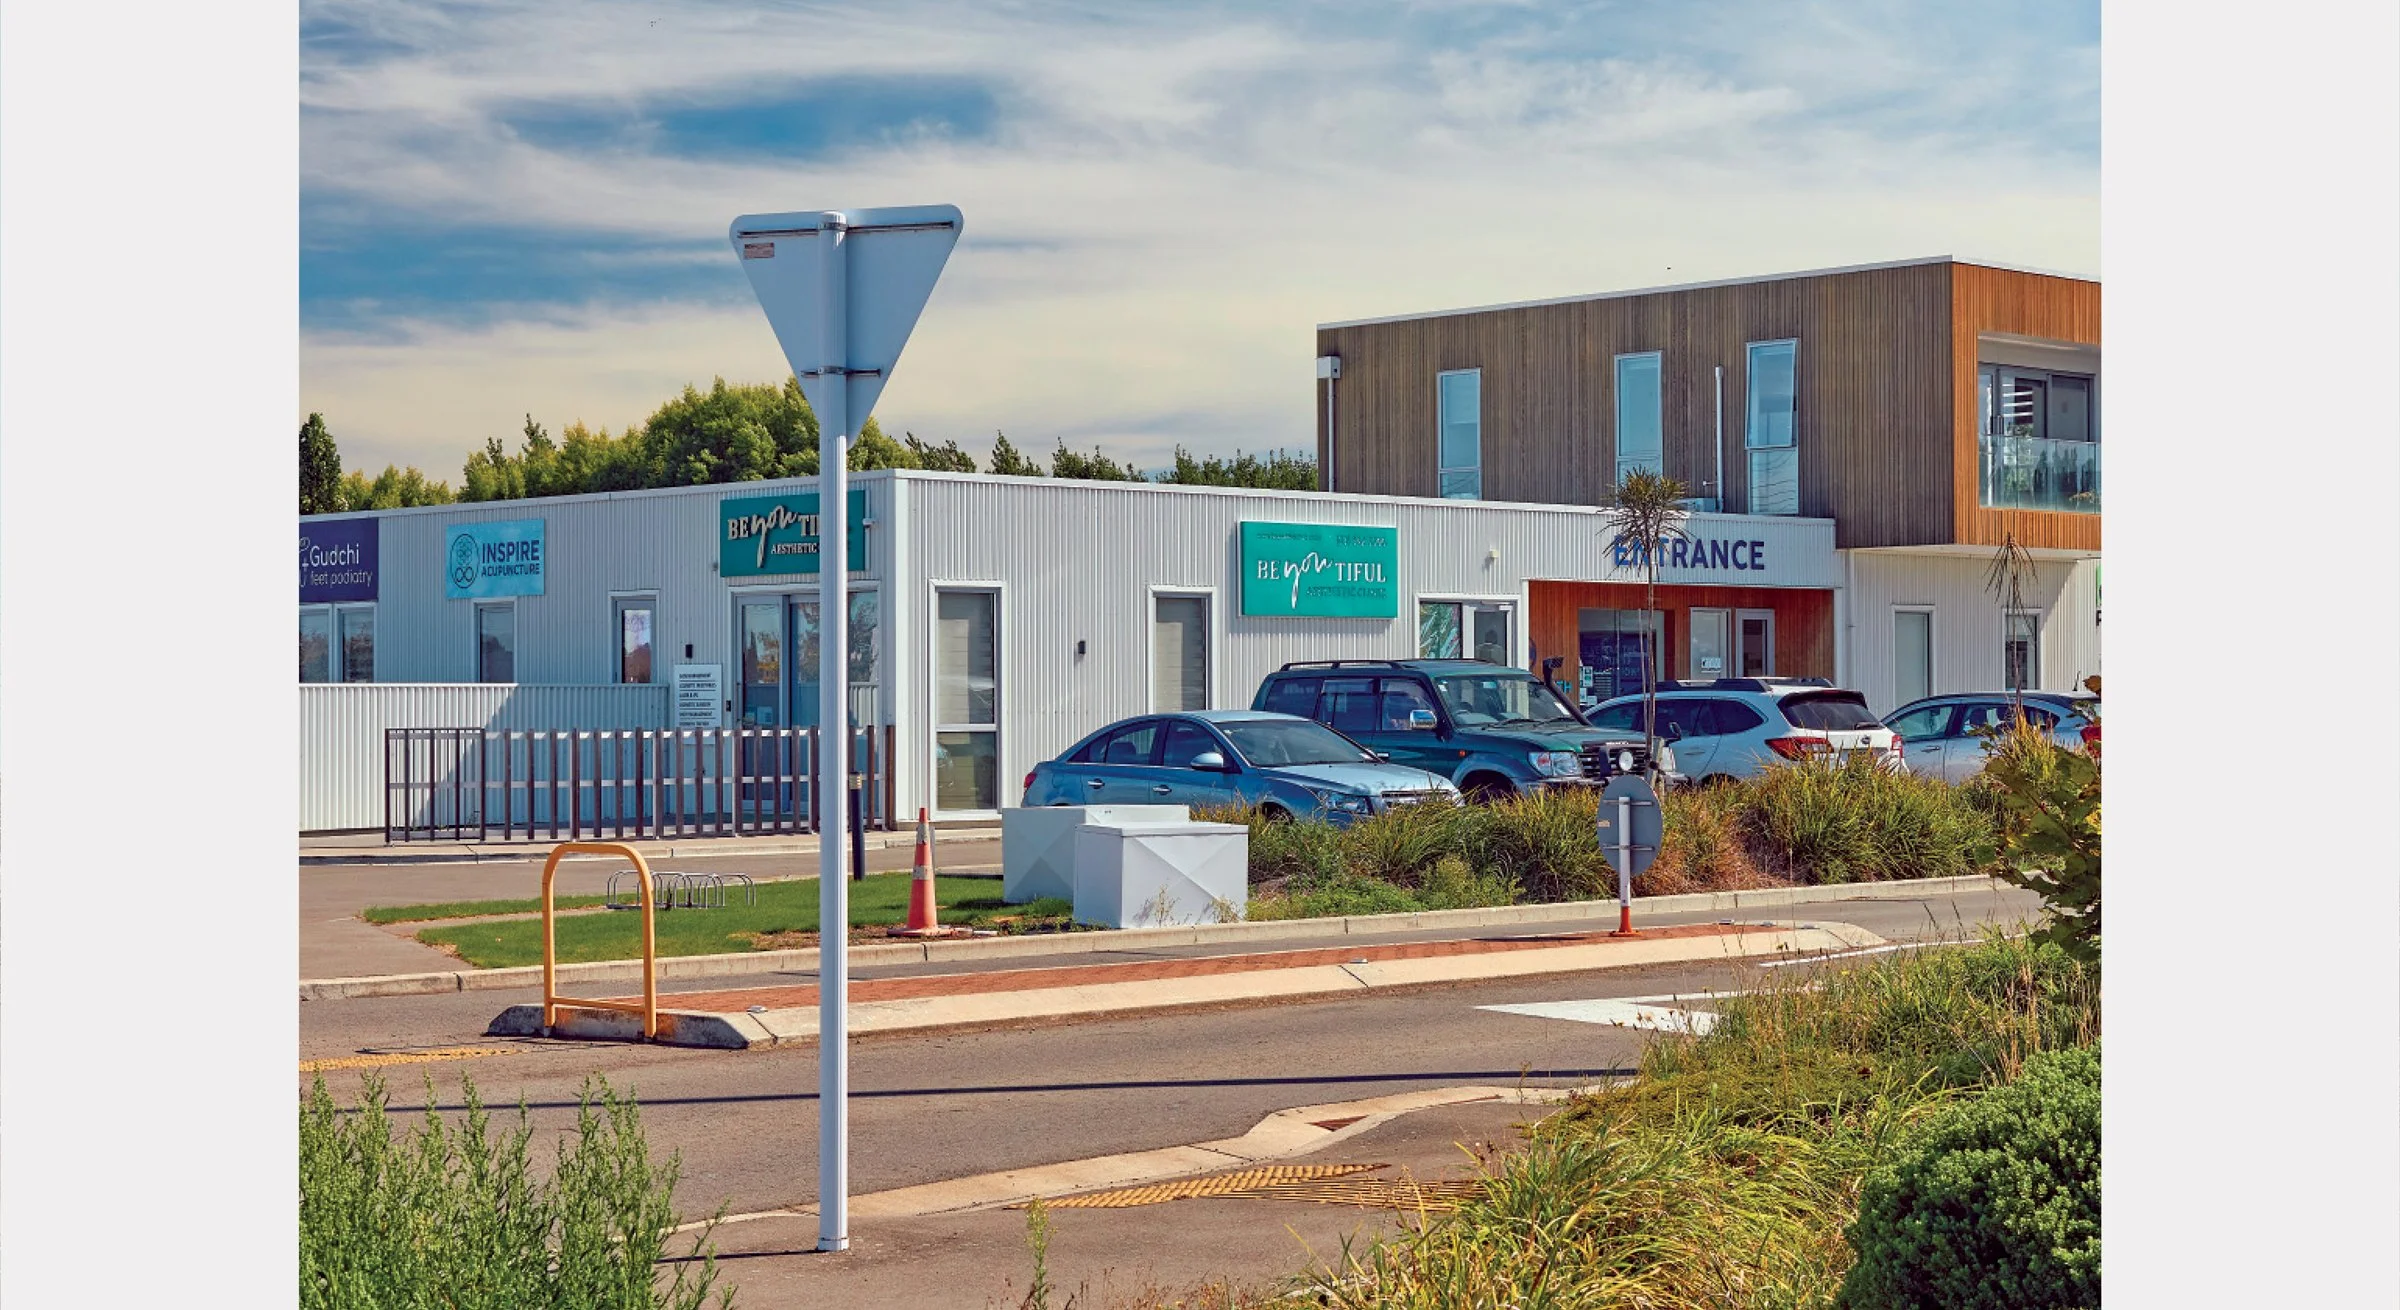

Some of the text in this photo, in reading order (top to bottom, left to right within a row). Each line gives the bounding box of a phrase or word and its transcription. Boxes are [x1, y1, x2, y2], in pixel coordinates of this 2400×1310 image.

[310, 543, 359, 567] Gudchi
[482, 540, 540, 563] INSPIRE
[771, 542, 817, 554] AESTHETIC
[1614, 534, 1765, 571] ENTRANCE
[311, 569, 373, 588] feet podiatry
[481, 563, 540, 577] ACUPUNCTURE
